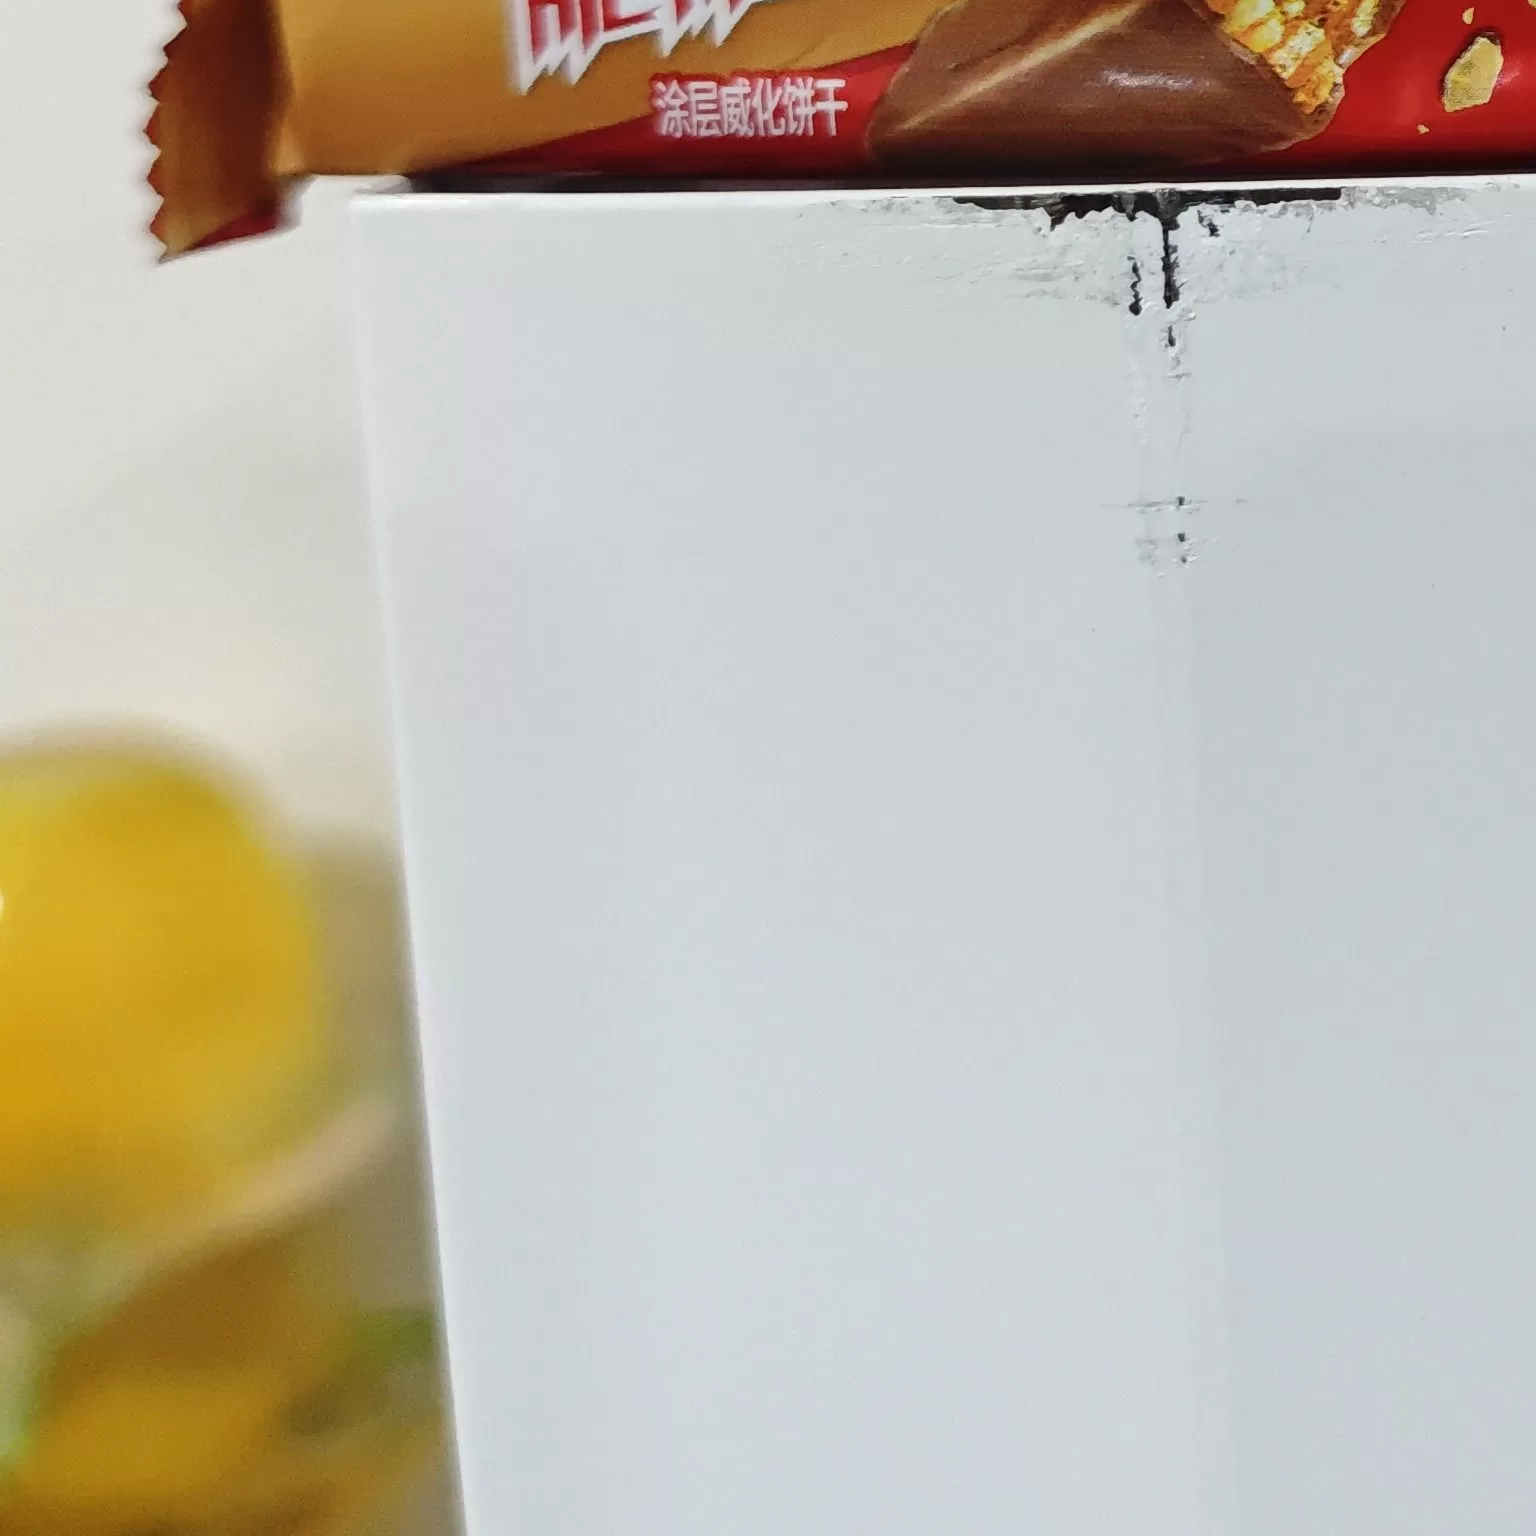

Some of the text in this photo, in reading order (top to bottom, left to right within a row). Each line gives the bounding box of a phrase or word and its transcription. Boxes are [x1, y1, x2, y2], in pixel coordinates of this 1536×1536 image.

[655, 76, 849, 138] 涂层威化饼干
